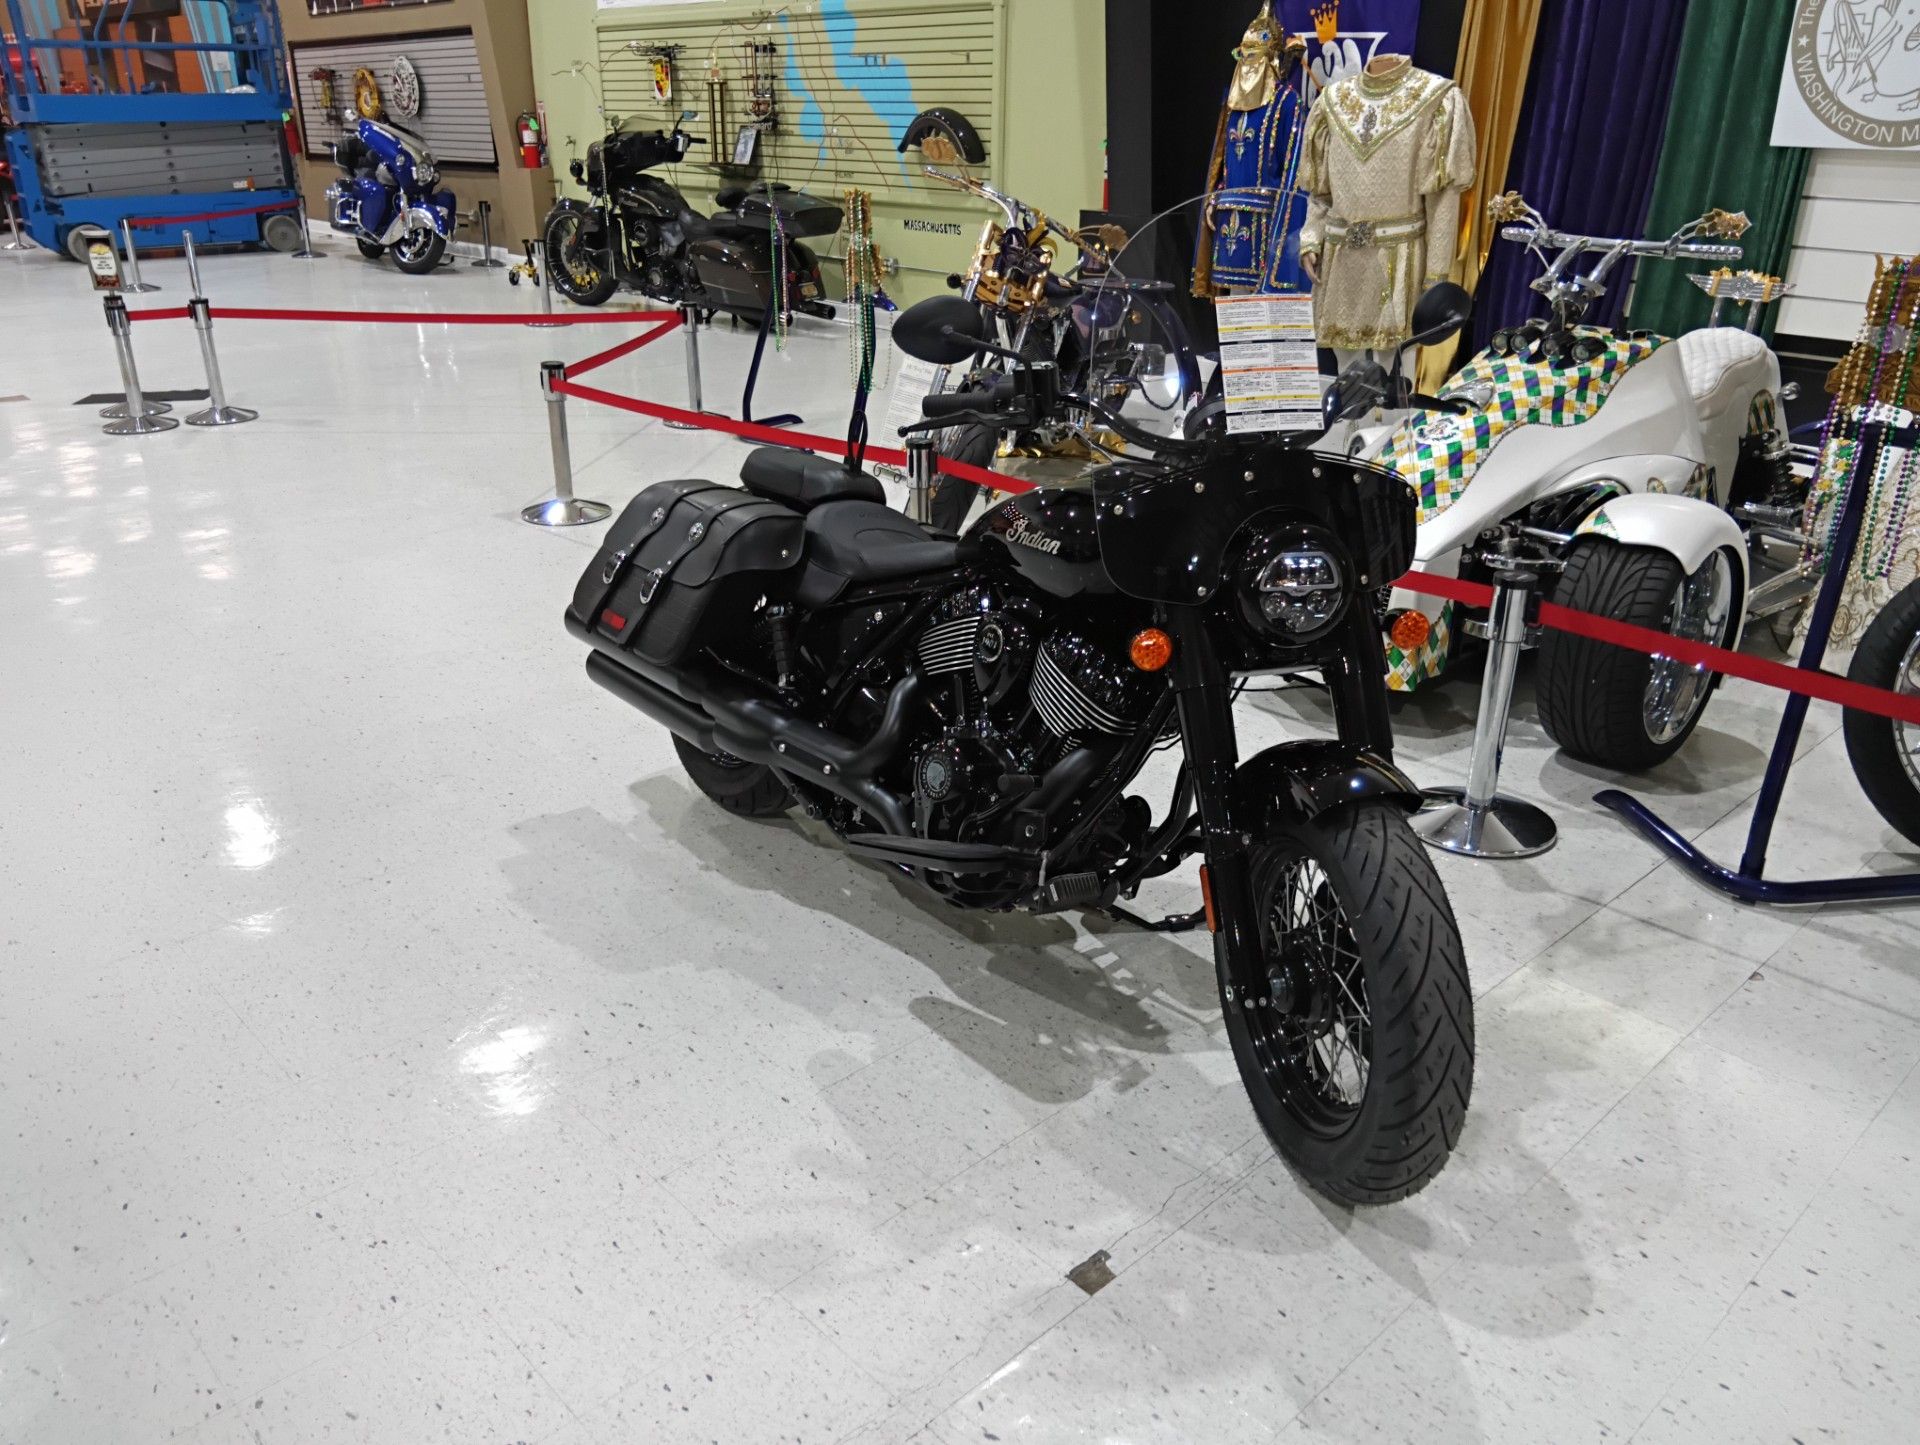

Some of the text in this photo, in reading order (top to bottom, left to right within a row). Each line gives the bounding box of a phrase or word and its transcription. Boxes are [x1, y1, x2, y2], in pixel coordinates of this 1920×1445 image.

[1796, 52, 1895, 143] WASHINGTON
[903, 219, 962, 236] MASSACHUSETTS
[1005, 519, 1061, 555] Indian
